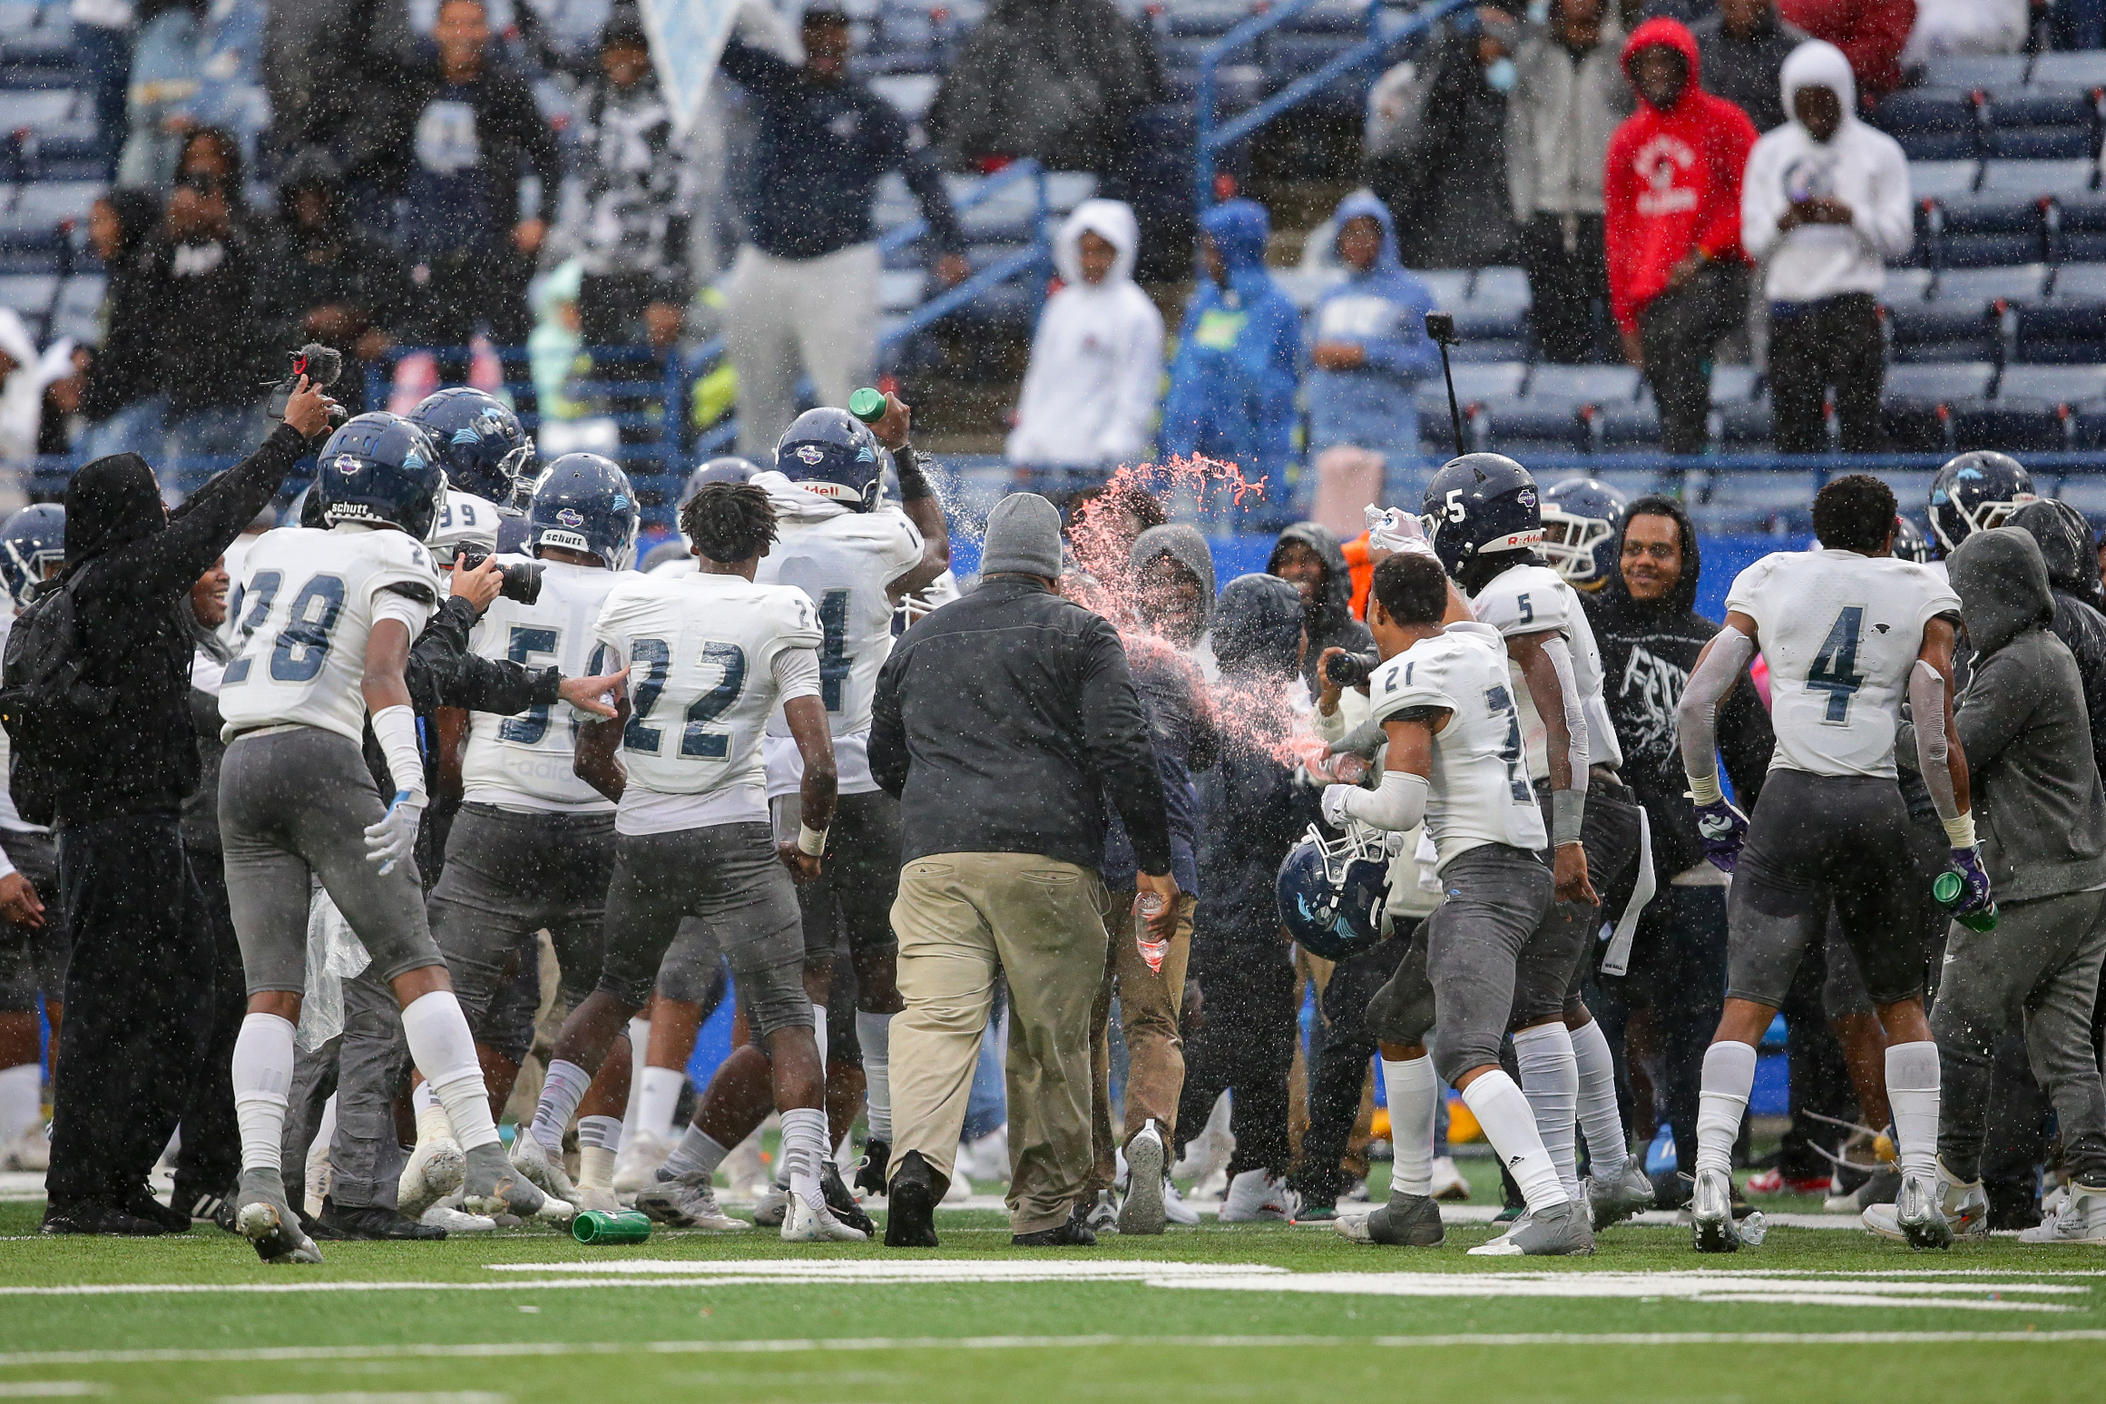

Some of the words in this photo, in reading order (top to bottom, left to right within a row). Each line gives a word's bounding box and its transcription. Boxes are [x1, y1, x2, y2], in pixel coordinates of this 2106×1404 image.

[332, 501, 369, 514] schutt
[1446, 488, 1466, 523] 5
[545, 533, 582, 545] schutt
[1518, 593, 1533, 624] 5
[221, 571, 346, 685] 28
[1385, 661, 1414, 691] 21
[1806, 606, 1865, 722] 4
[624, 638, 746, 758] 22
